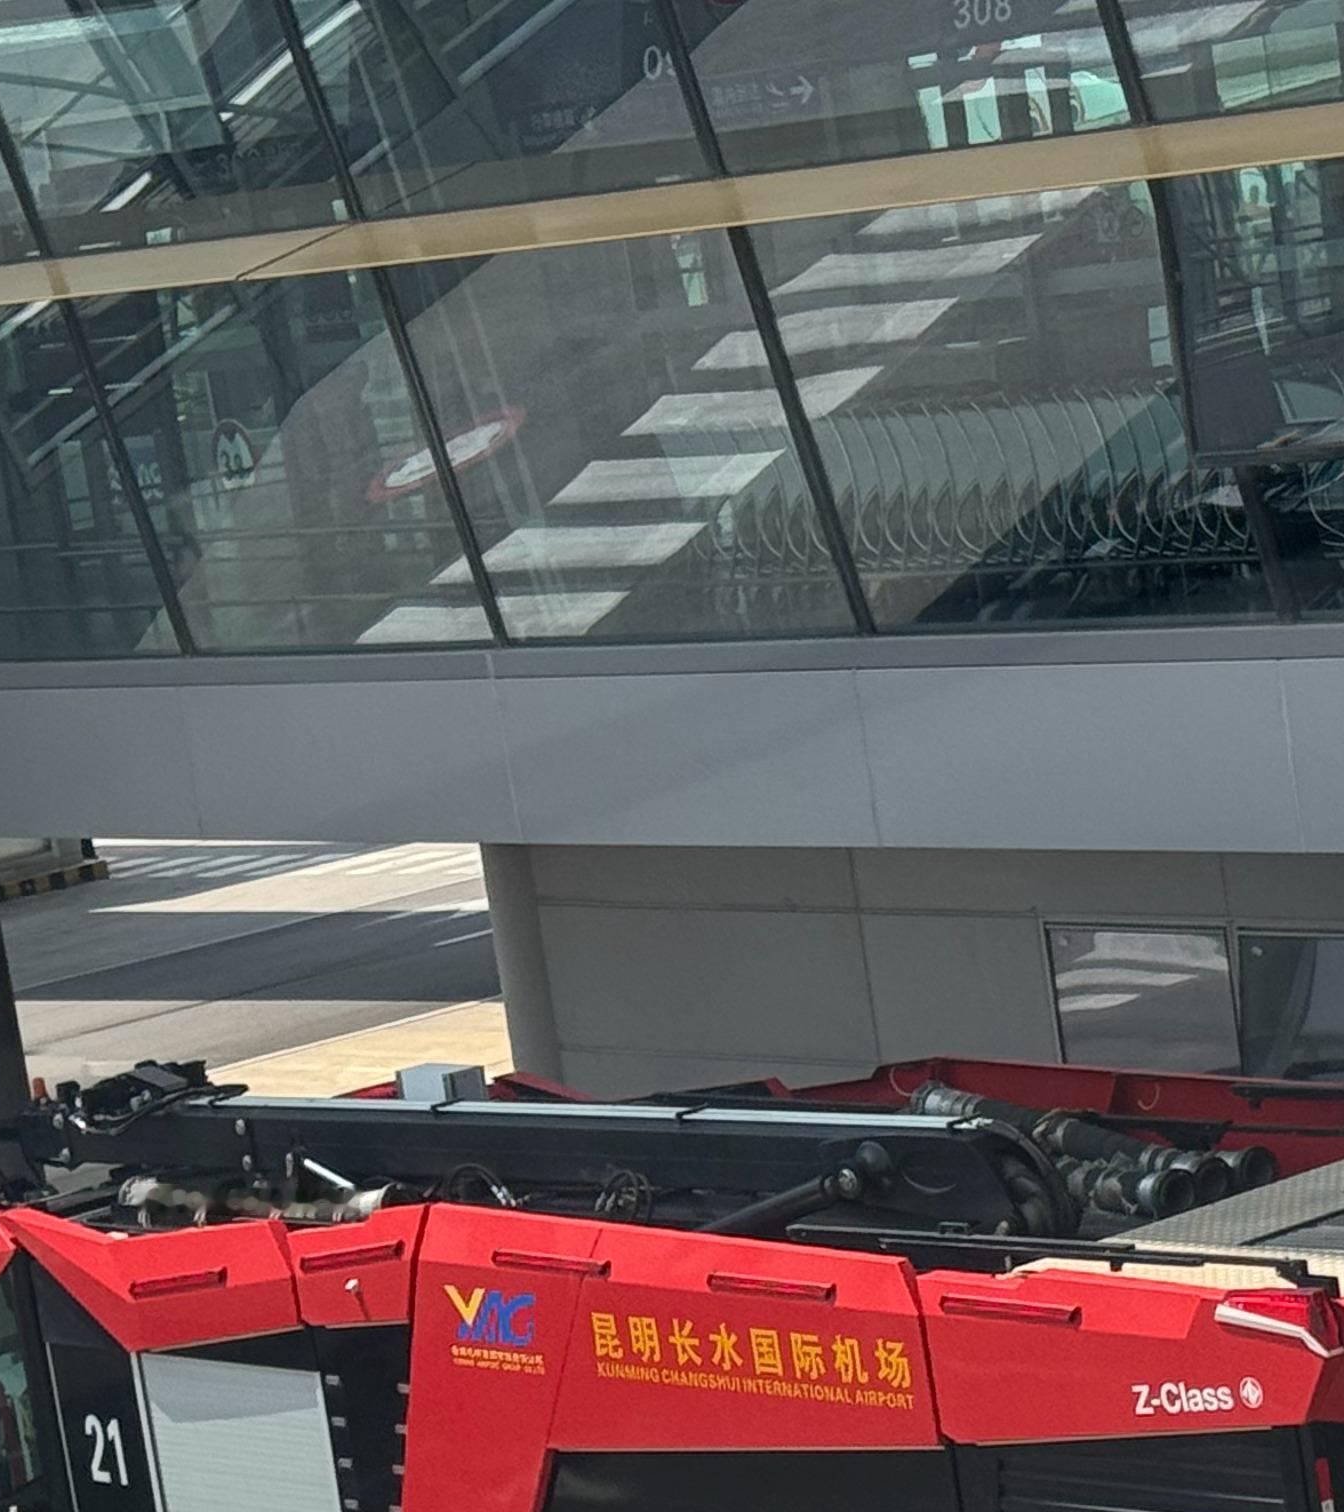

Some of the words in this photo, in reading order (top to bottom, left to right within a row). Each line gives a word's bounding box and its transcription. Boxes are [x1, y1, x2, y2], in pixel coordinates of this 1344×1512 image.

[590, 1311, 912, 1389] 昆明长水国际机场
[596, 1361, 661, 1383] KUNMING
[661, 1368, 742, 1392] CHANGSHUI
[743, 1375, 854, 1405] INTERNATIONAL
[855, 1390, 915, 1411] AIRPORT
[1131, 1381, 1234, 1416] Z-Class
[84, 1414, 129, 1487] 21
